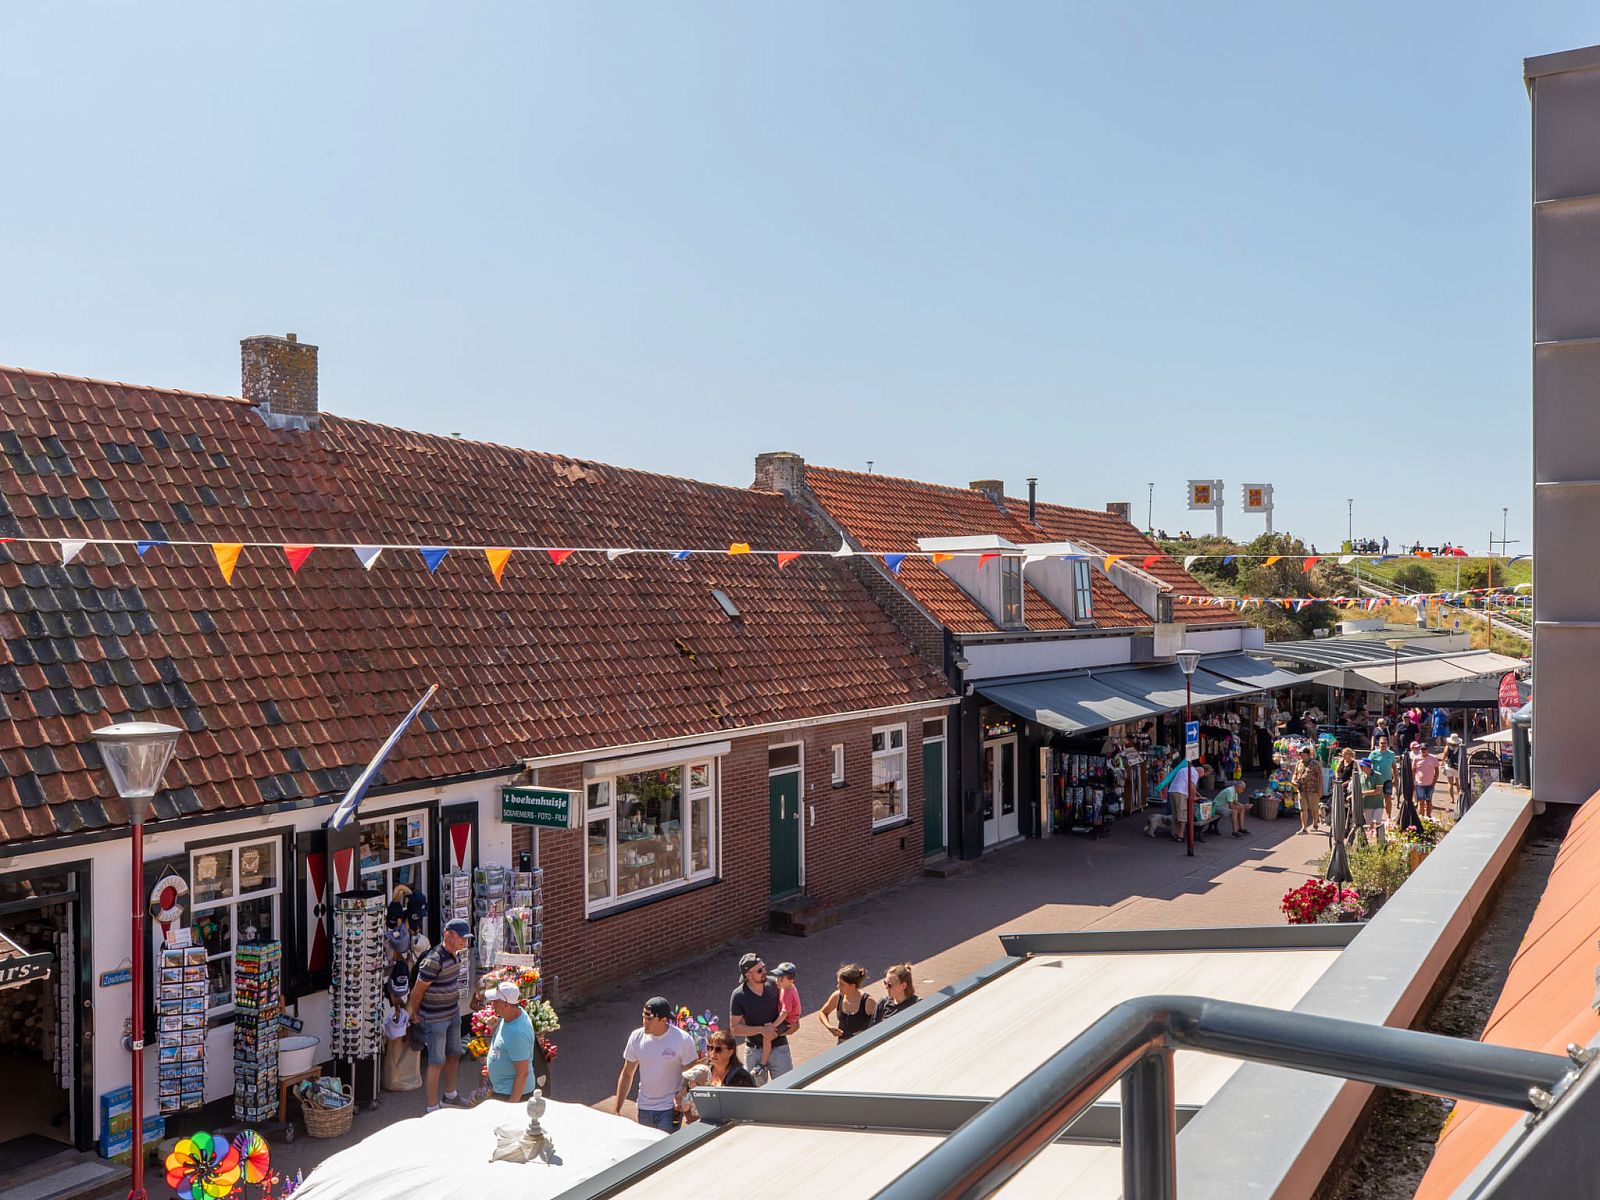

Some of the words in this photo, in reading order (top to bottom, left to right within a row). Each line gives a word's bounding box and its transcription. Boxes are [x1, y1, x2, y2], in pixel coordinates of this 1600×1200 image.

[511, 794, 567, 809] boekenhuisje
[537, 812, 552, 821] FOTO
[555, 813, 567, 822] FILM
